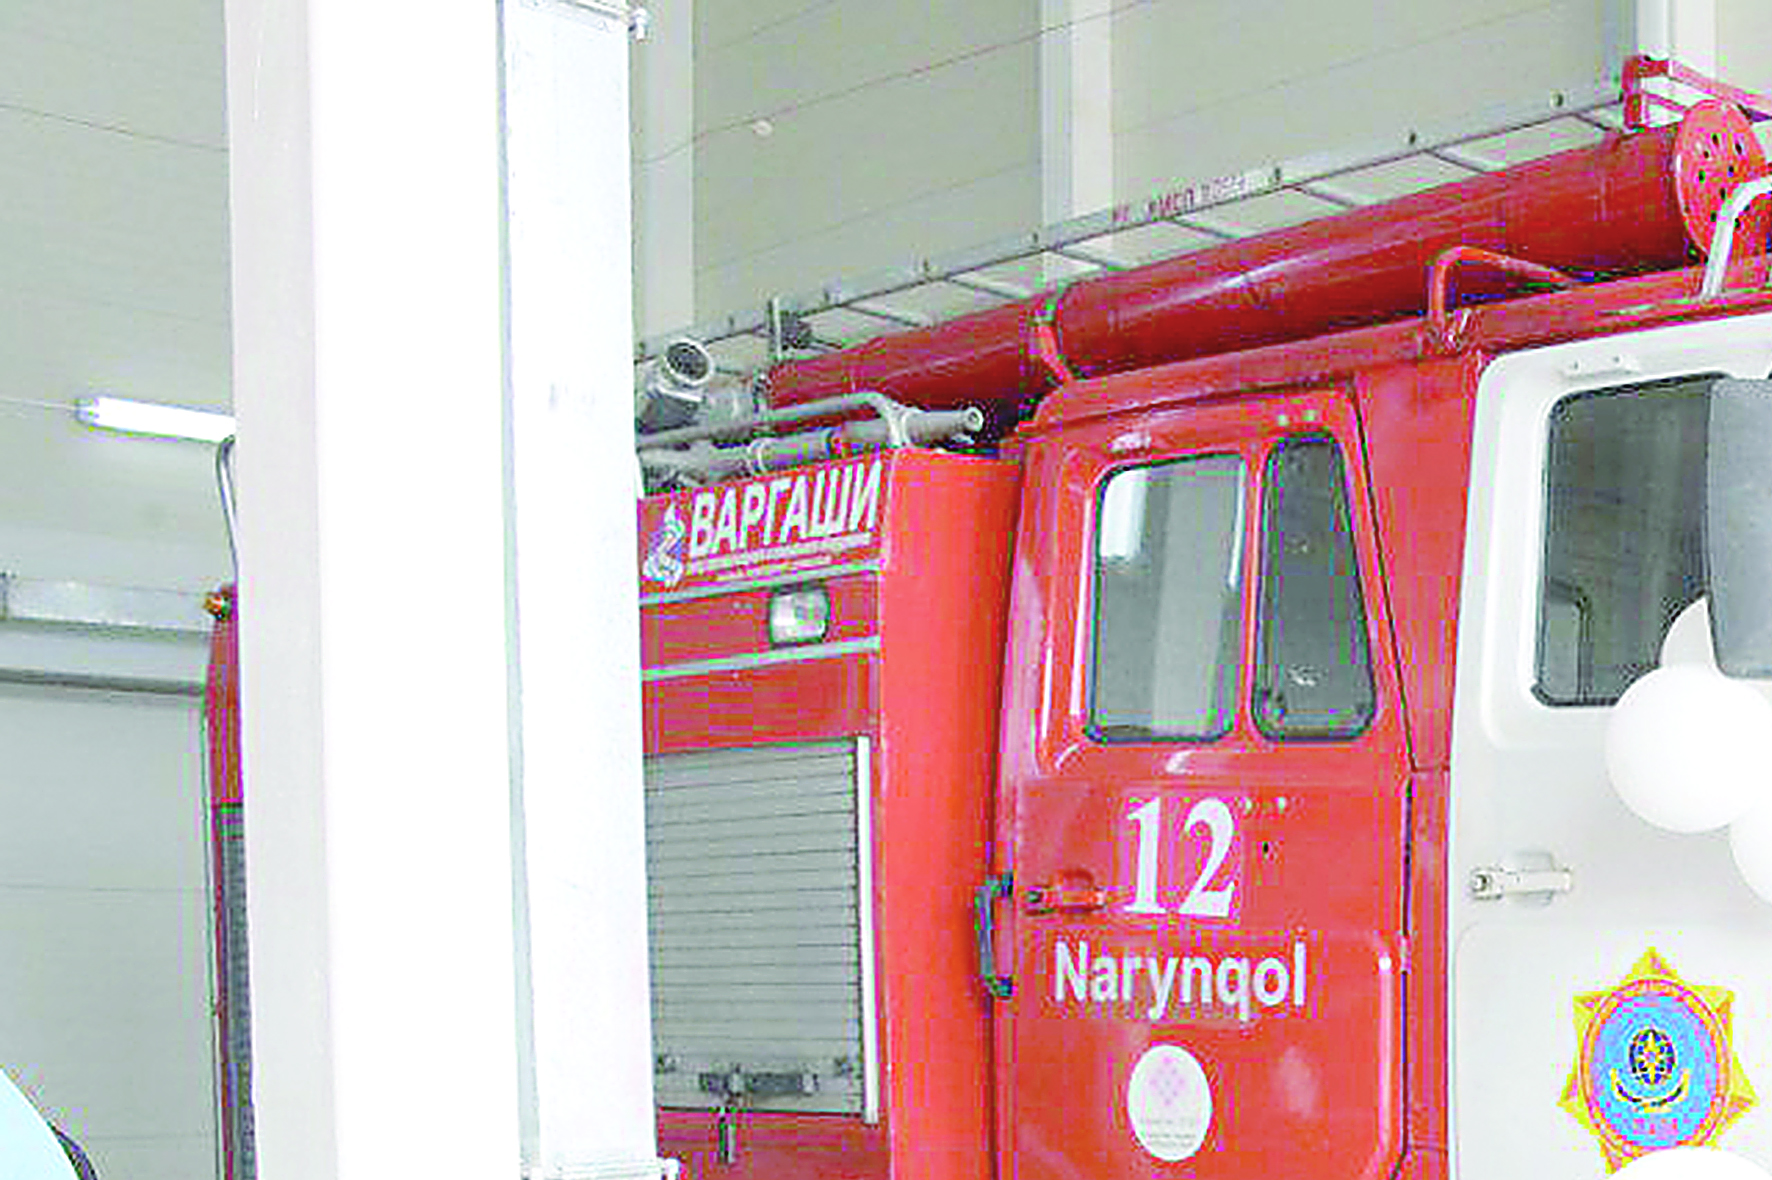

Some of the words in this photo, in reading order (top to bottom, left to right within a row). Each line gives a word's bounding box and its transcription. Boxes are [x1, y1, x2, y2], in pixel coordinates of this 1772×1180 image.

[690, 460, 882, 557] ВАРГАШИ
[1123, 798, 1236, 917] 12
[1055, 940, 1307, 1021] Narynqol
